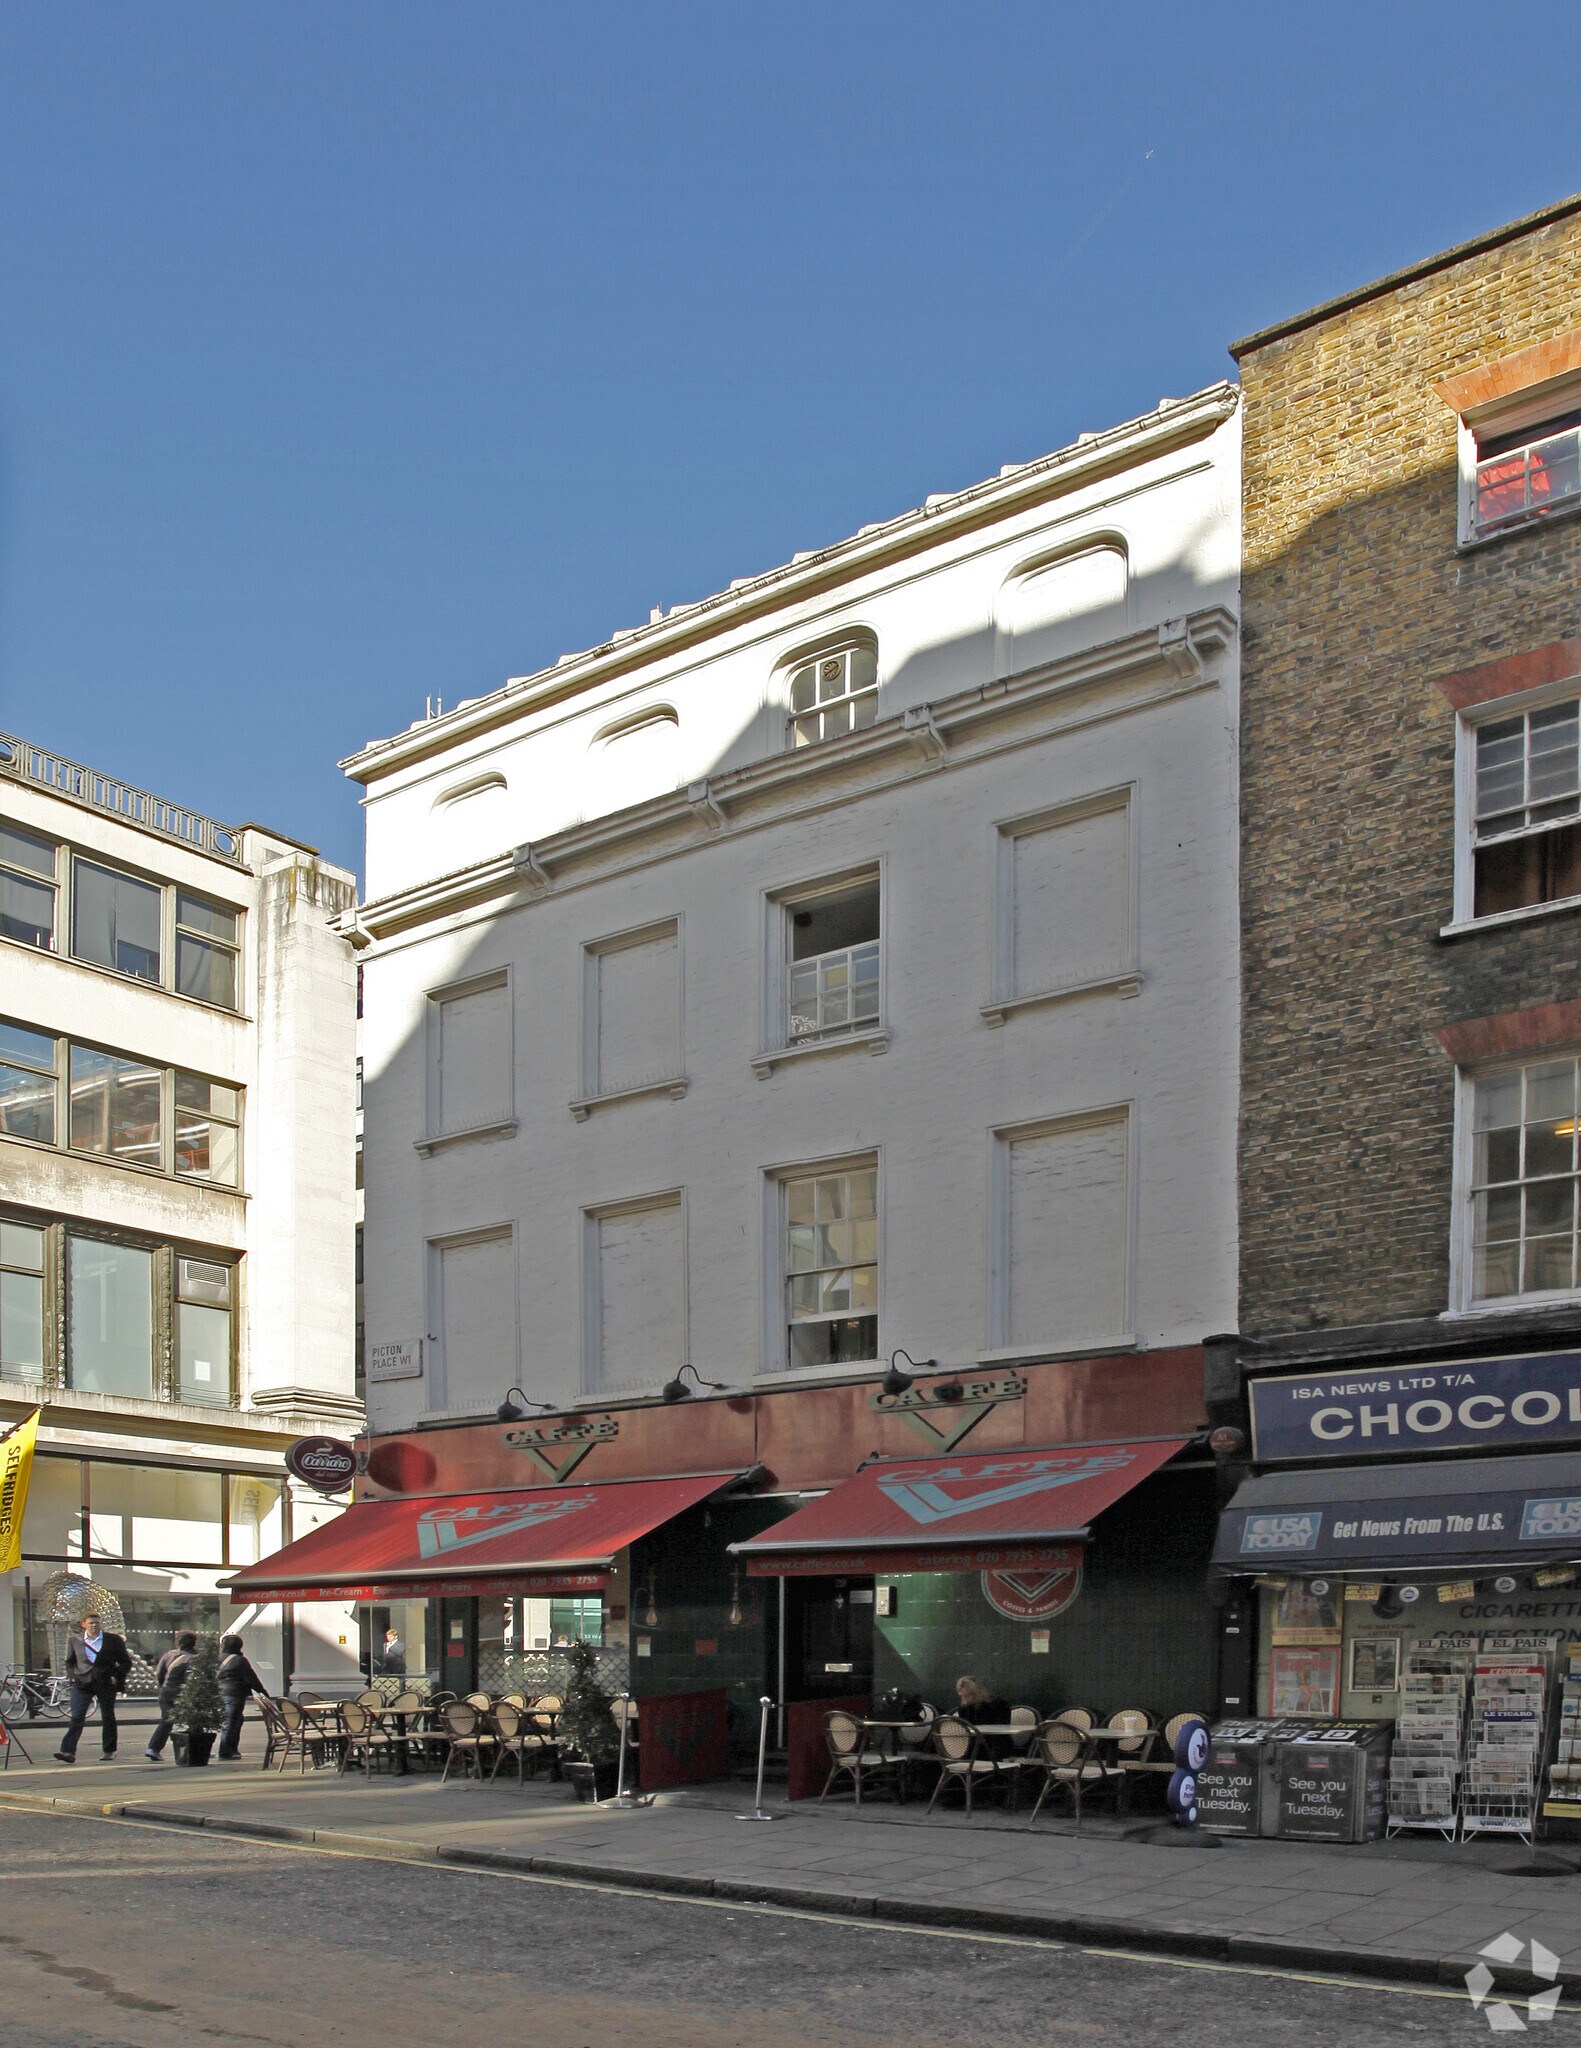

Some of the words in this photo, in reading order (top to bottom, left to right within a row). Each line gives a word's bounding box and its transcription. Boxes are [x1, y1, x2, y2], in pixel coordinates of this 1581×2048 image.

[372, 1345, 402, 1357] PICTON
[372, 1357, 397, 1369] PLACE
[400, 1355, 411, 1365] W1
[1292, 1388, 1326, 1400] ISA
[1331, 1381, 1391, 1397] NEWS
[1398, 1376, 1436, 1391] LTD
[1443, 1373, 1476, 1387] T/A
[303, 1455, 349, 1469] Carraro
[1271, 1517, 1312, 1533] USA
[1333, 1520, 1359, 1538] Get
[1361, 1519, 1400, 1537] News
[1403, 1517, 1442, 1535] From
[1446, 1515, 1474, 1533] The
[1478, 1513, 1505, 1531] U.S.
[1247, 1532, 1313, 1549] TODAY
[917, 1555, 971, 1567] catering
[240, 1589, 307, 1600] www.caffe-v.co.uk
[319, 1588, 363, 1598] Ice-Cream
[412, 1583, 430, 1593] Bar
[1418, 1640, 1436, 1649] EL
[1440, 1640, 1471, 1648] PAIS
[1493, 1639, 1511, 1648] EL
[1514, 1639, 1547, 1648] PAIS
[1197, 1772, 1225, 1785] See
[1228, 1776, 1252, 1788] you
[1289, 1777, 1317, 1790] See
[1320, 1780, 1346, 1793] you
[1211, 1787, 1239, 1798] next
[1301, 1793, 1331, 1803] next
[1195, 1797, 1251, 1813] Tuesday.
[1286, 1802, 1345, 1820] Tuesday.
